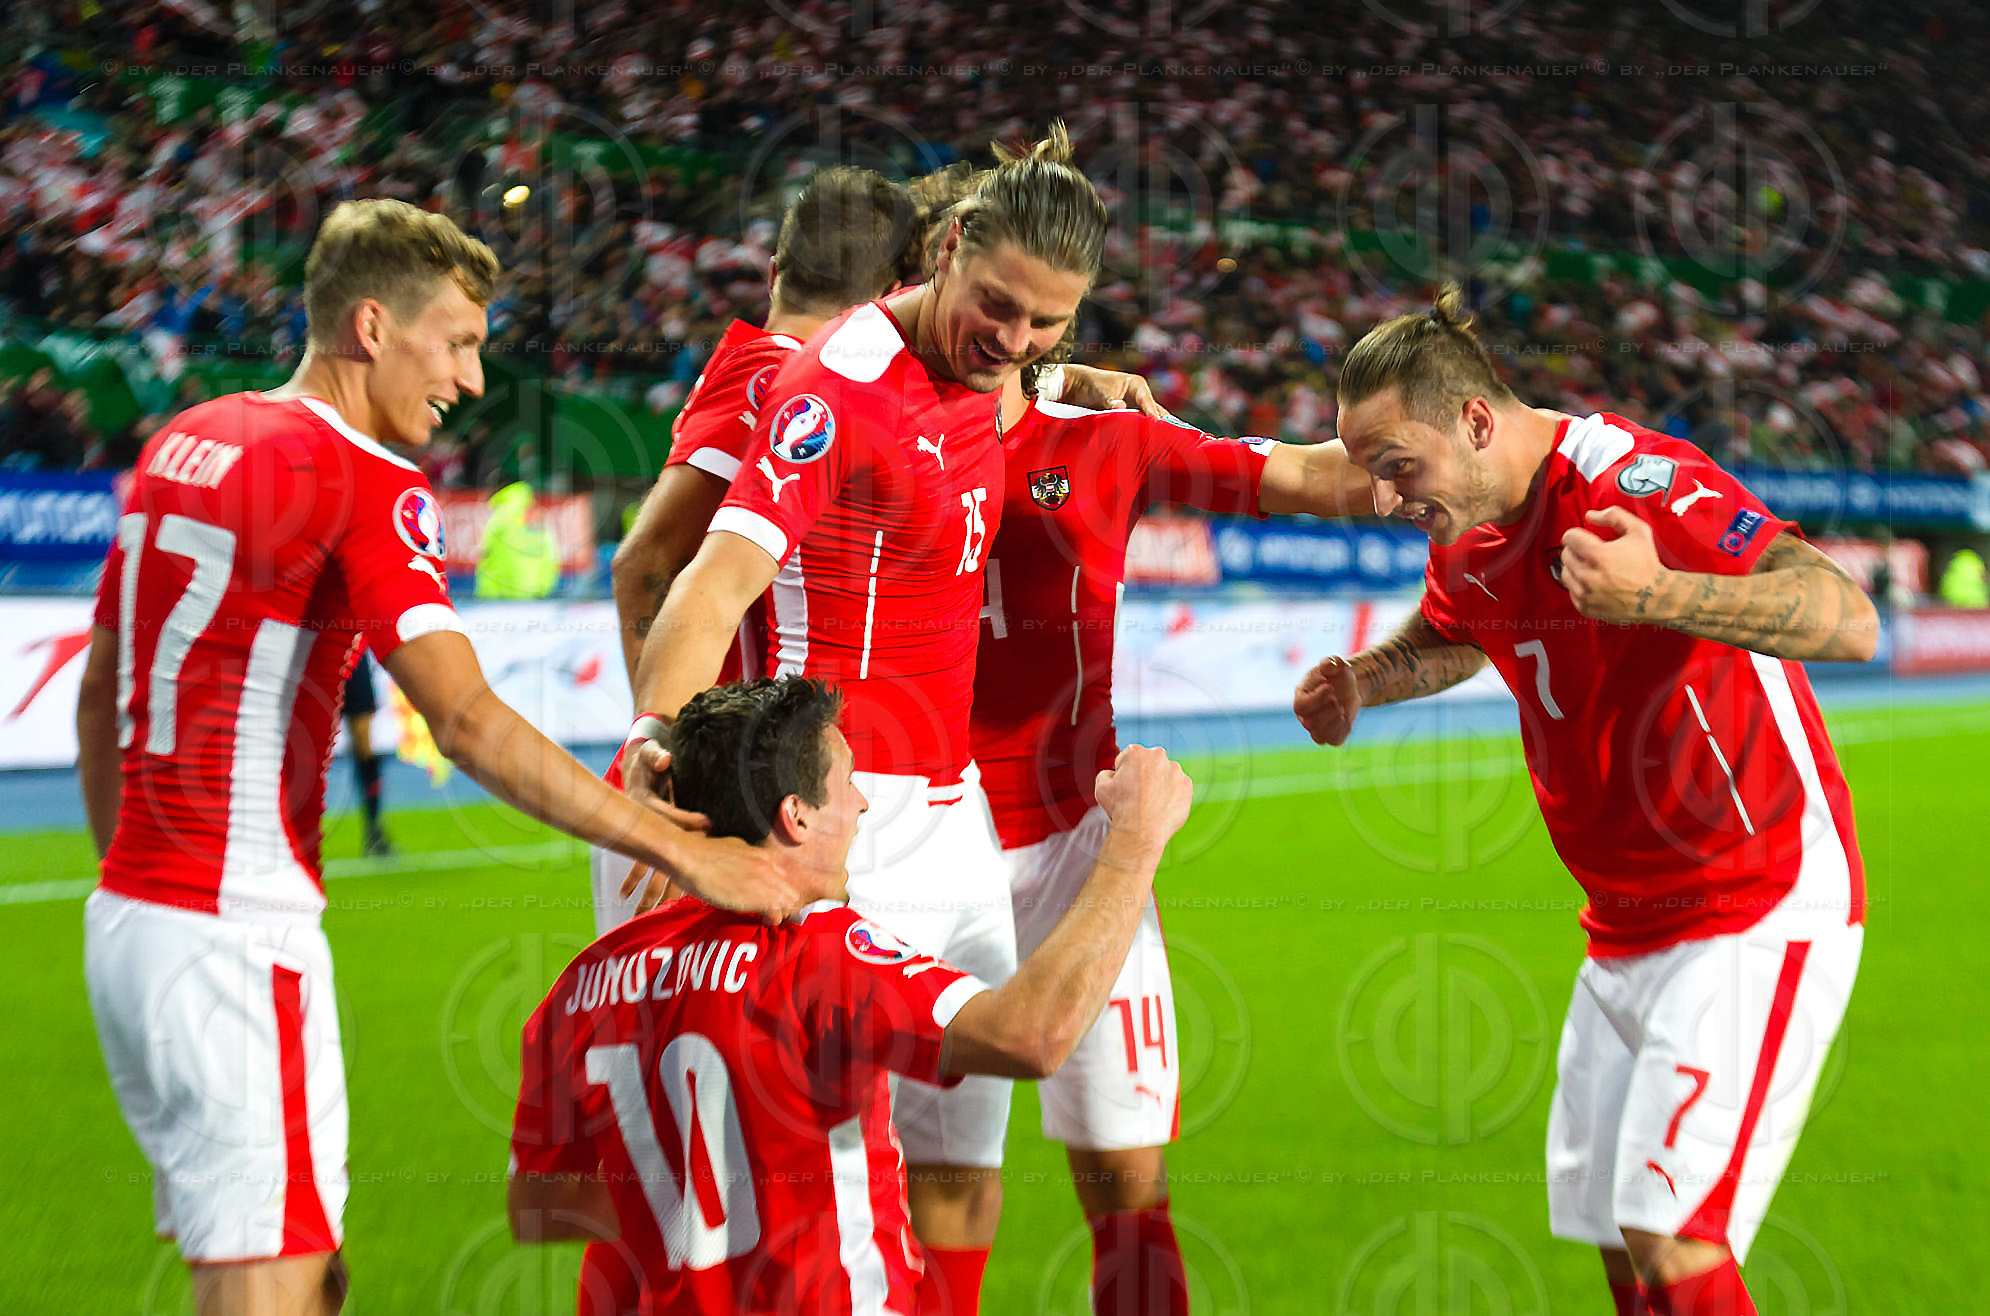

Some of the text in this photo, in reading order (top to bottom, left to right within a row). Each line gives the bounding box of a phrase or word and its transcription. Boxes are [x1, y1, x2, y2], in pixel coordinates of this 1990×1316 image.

[145, 432, 244, 489] KLEIN
[956, 487, 987, 576] 15
[117, 512, 237, 756] 17
[1514, 638, 1564, 720] 7
[565, 939, 758, 1016] JUNUZOVIC
[1109, 995, 1167, 1073] 14
[1664, 1064, 1711, 1149] 7
[585, 1032, 762, 1271] 10
